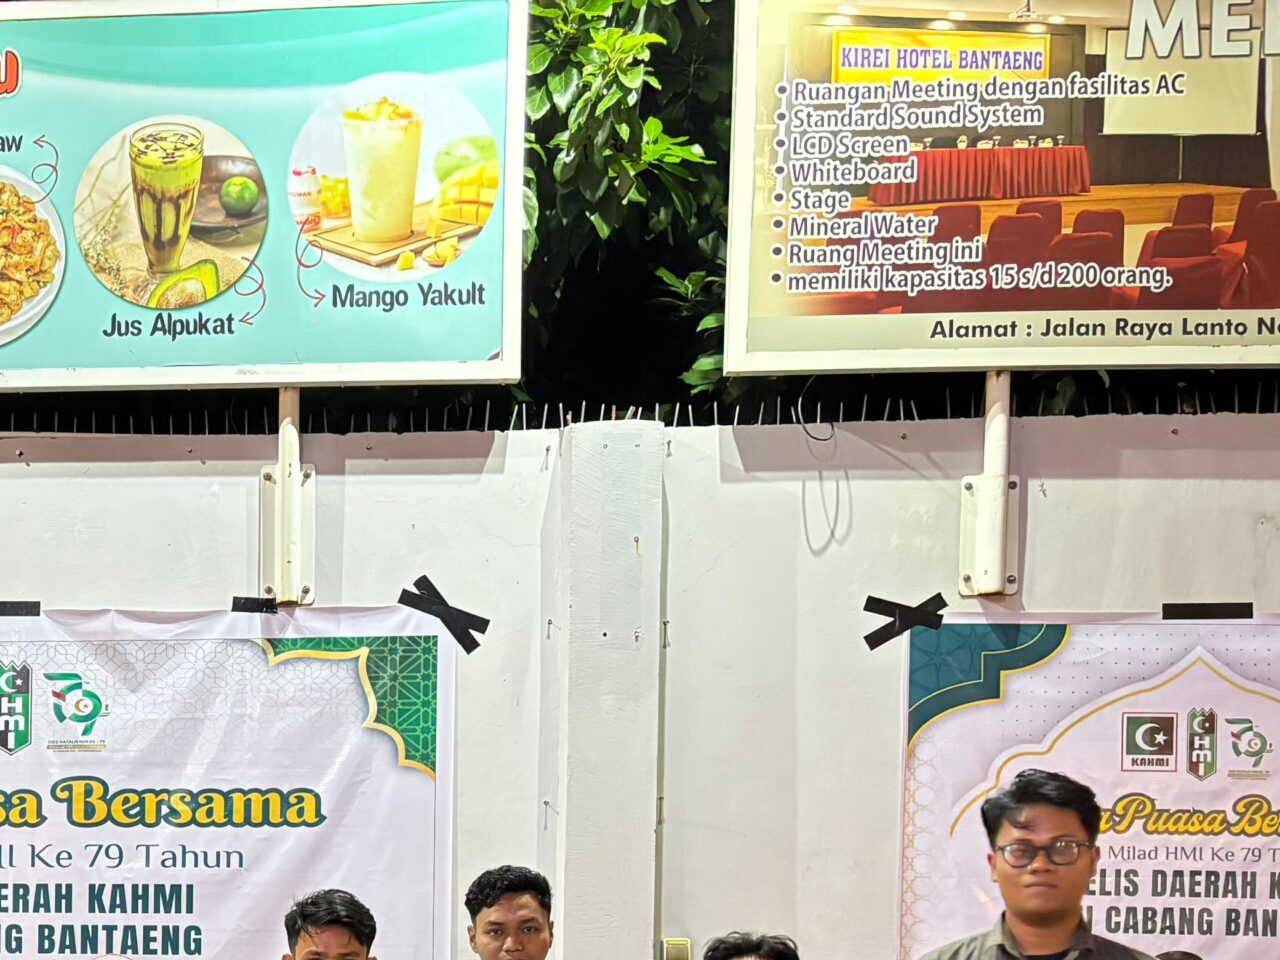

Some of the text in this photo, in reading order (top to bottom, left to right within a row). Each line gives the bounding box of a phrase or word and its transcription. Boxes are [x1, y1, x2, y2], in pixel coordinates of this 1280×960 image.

[1125, 0, 1280, 58] ME
[841, 47, 1044, 71] KIREI HOTEL BANTAENG
[794, 73, 1185, 105] Ruangan Meeting dengan fasilitas AC
[793, 104, 1042, 131] Standard Sound System
[793, 135, 908, 156] LCD Screen
[791, 158, 916, 182] Whiteboard
[791, 190, 850, 213] Stage
[790, 214, 936, 237] Mineral Water
[789, 239, 981, 268] Ruang Meeting ini
[788, 263, 1172, 295] memiliki kapasitas 15 s/d 200 orang.
[331, 282, 486, 312] Mango Yakult
[102, 311, 236, 343] Jus Alpukat
[930, 319, 1018, 339] Alamat
[1040, 318, 1111, 338] Jalan
[1115, 317, 1173, 343] Raya
[1182, 317, 1248, 336] Lanto
[1257, 316, 1280, 336] N
[1131, 757, 1170, 767] KAHMI
[50, 775, 327, 829] Bersama
[1112, 792, 1228, 836] Puasa
[27, 843, 73, 869] Ke
[83, 843, 124, 869] 79
[136, 843, 245, 869] Tahun
[1108, 845, 1158, 862] Milad
[1165, 846, 1203, 862] HMI
[1211, 847, 1235, 862] Ke
[1241, 847, 1262, 863] 79
[88, 883, 195, 914] KAHMI
[1151, 869, 1257, 899] DAERAH
[1105, 905, 1214, 936] CABANG
[1225, 908, 1280, 937] BAN
[37, 924, 203, 956] BANTAENG
